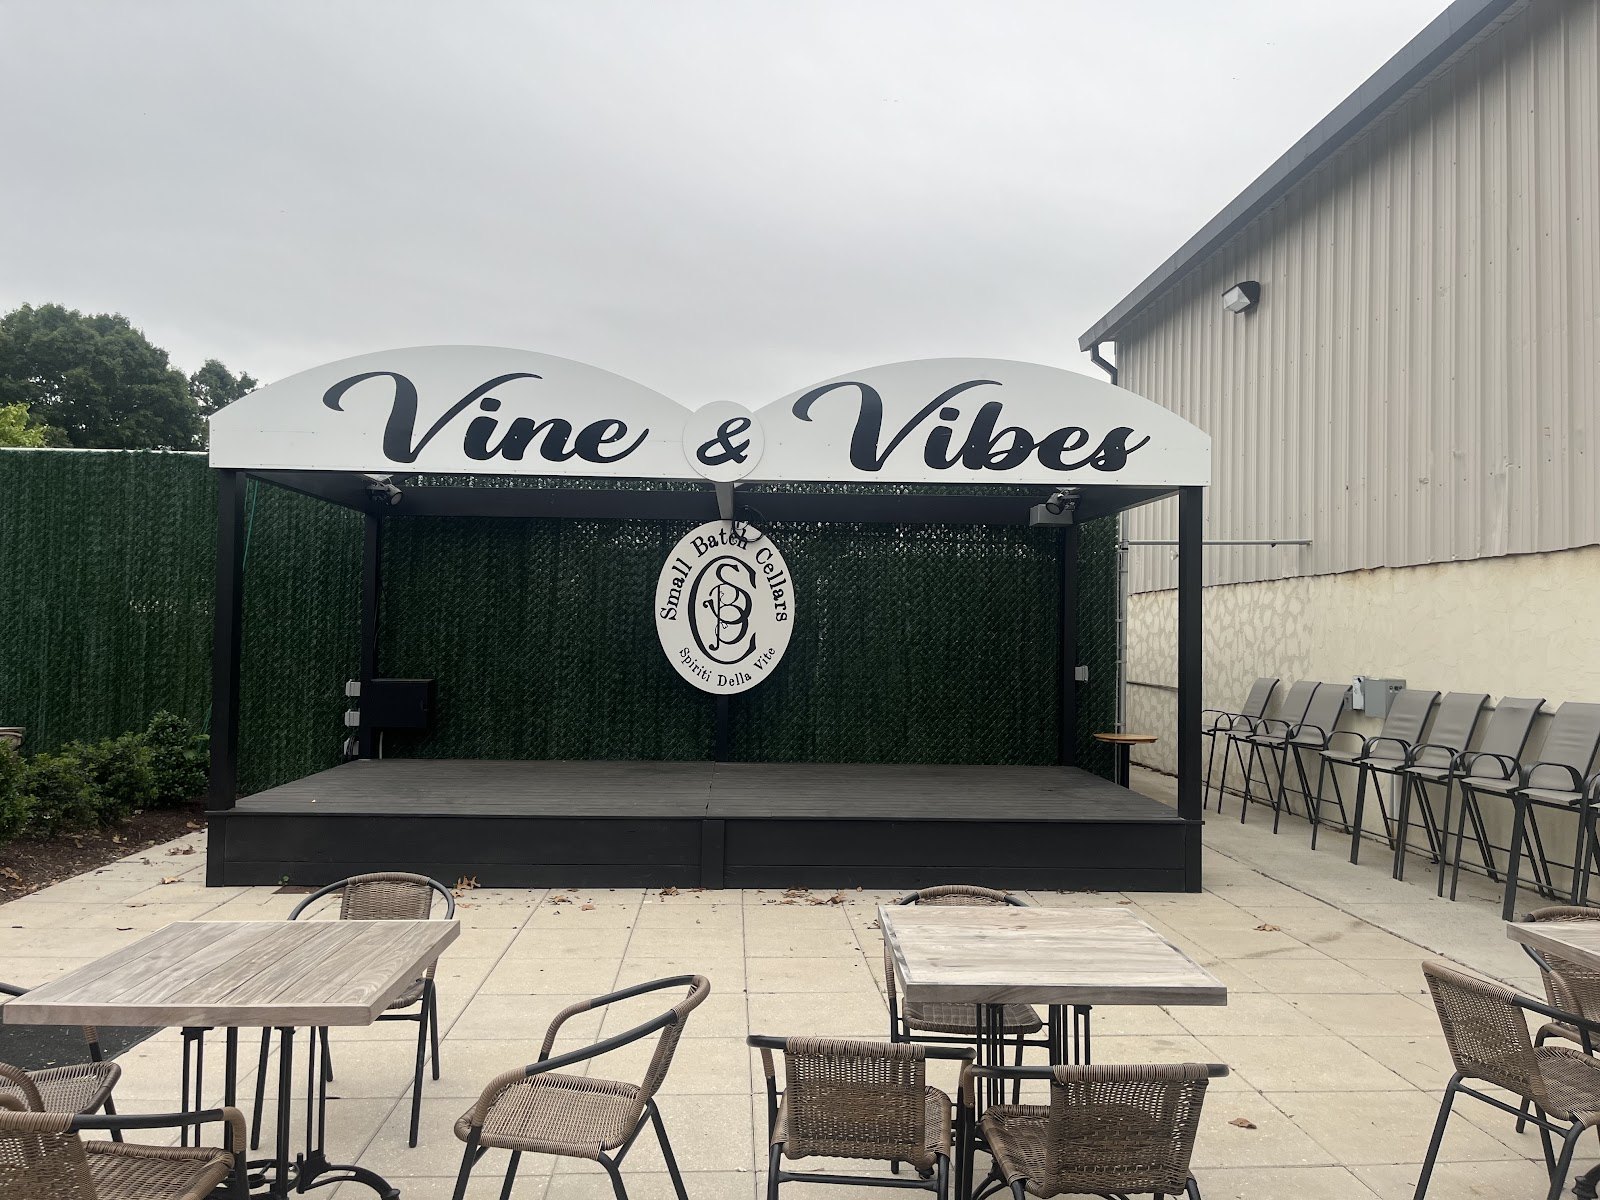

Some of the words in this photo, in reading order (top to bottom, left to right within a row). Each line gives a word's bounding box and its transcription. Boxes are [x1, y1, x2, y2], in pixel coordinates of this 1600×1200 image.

[322, 371, 649, 464] Vine
[696, 416, 752, 466] &
[792, 379, 1150, 472] Vibes
[659, 557, 692, 622] Small
[755, 547, 788, 622] Cellars
[679, 647, 712, 683] Spiriti
[717, 672, 752, 687] Della
[753, 647, 776, 671] Vite
